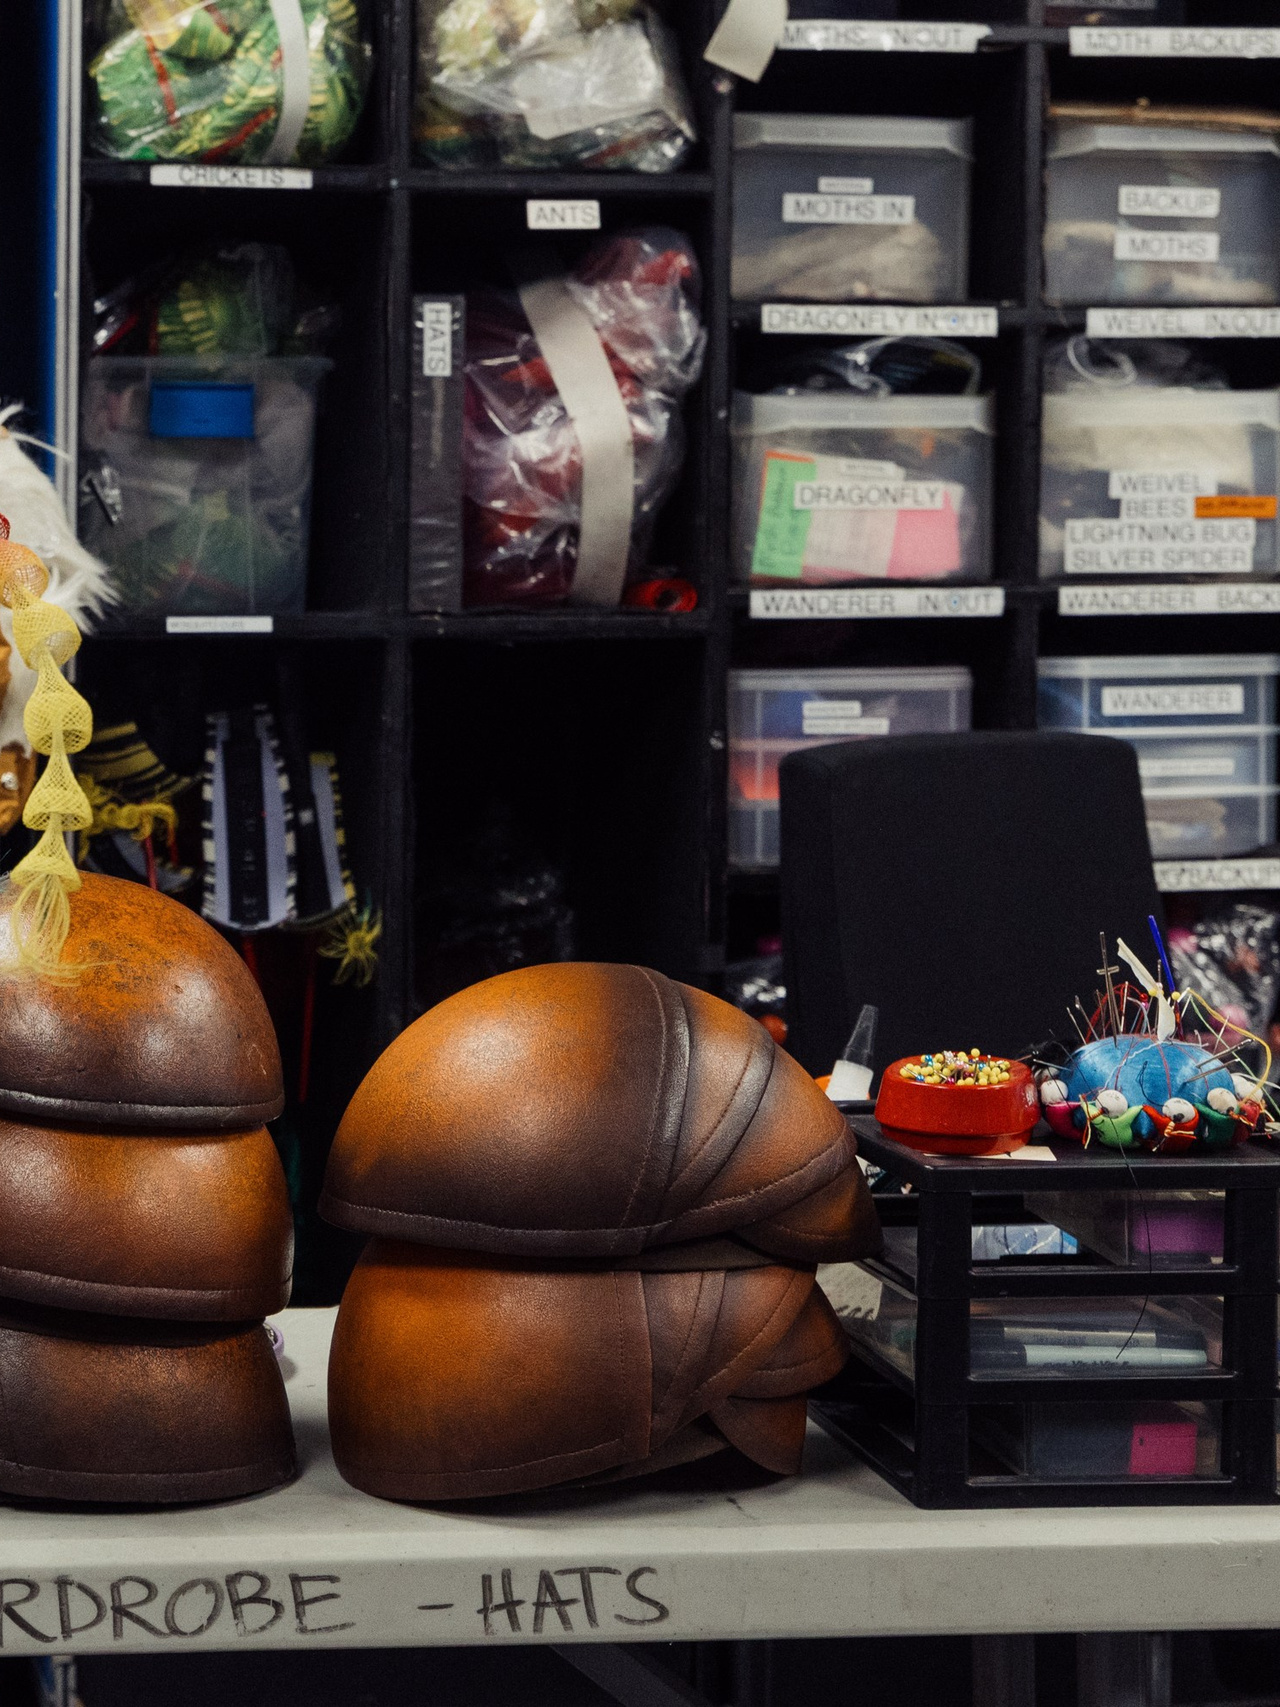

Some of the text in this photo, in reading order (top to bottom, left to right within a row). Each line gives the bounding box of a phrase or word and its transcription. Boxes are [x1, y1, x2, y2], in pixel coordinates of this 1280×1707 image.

[1086, 32, 1150, 50] MOTH
[178, 165, 286, 187] CRICKETS
[793, 200, 904, 221] MOTHS IN
[1125, 190, 1214, 211] BACKUP
[535, 205, 596, 224] ANTS
[1128, 237, 1209, 257] MOTHS
[768, 309, 908, 330] DRAGONFLY
[1104, 314, 1188, 333] WEIVEL
[426, 307, 447, 373] HATS
[1119, 476, 1200, 494] WEIVEL
[800, 486, 941, 506] DRAGONFLY
[1125, 500, 1188, 519] BEES
[1070, 523, 1252, 544] LIGHTNING BUG
[1072, 549, 1250, 569] SILVER SPIDER
[763, 594, 897, 614] WANDERER
[1064, 592, 1197, 610] WANDERER
[1110, 692, 1232, 710] WANDERER
[476, 1566, 671, 1636] HATS
